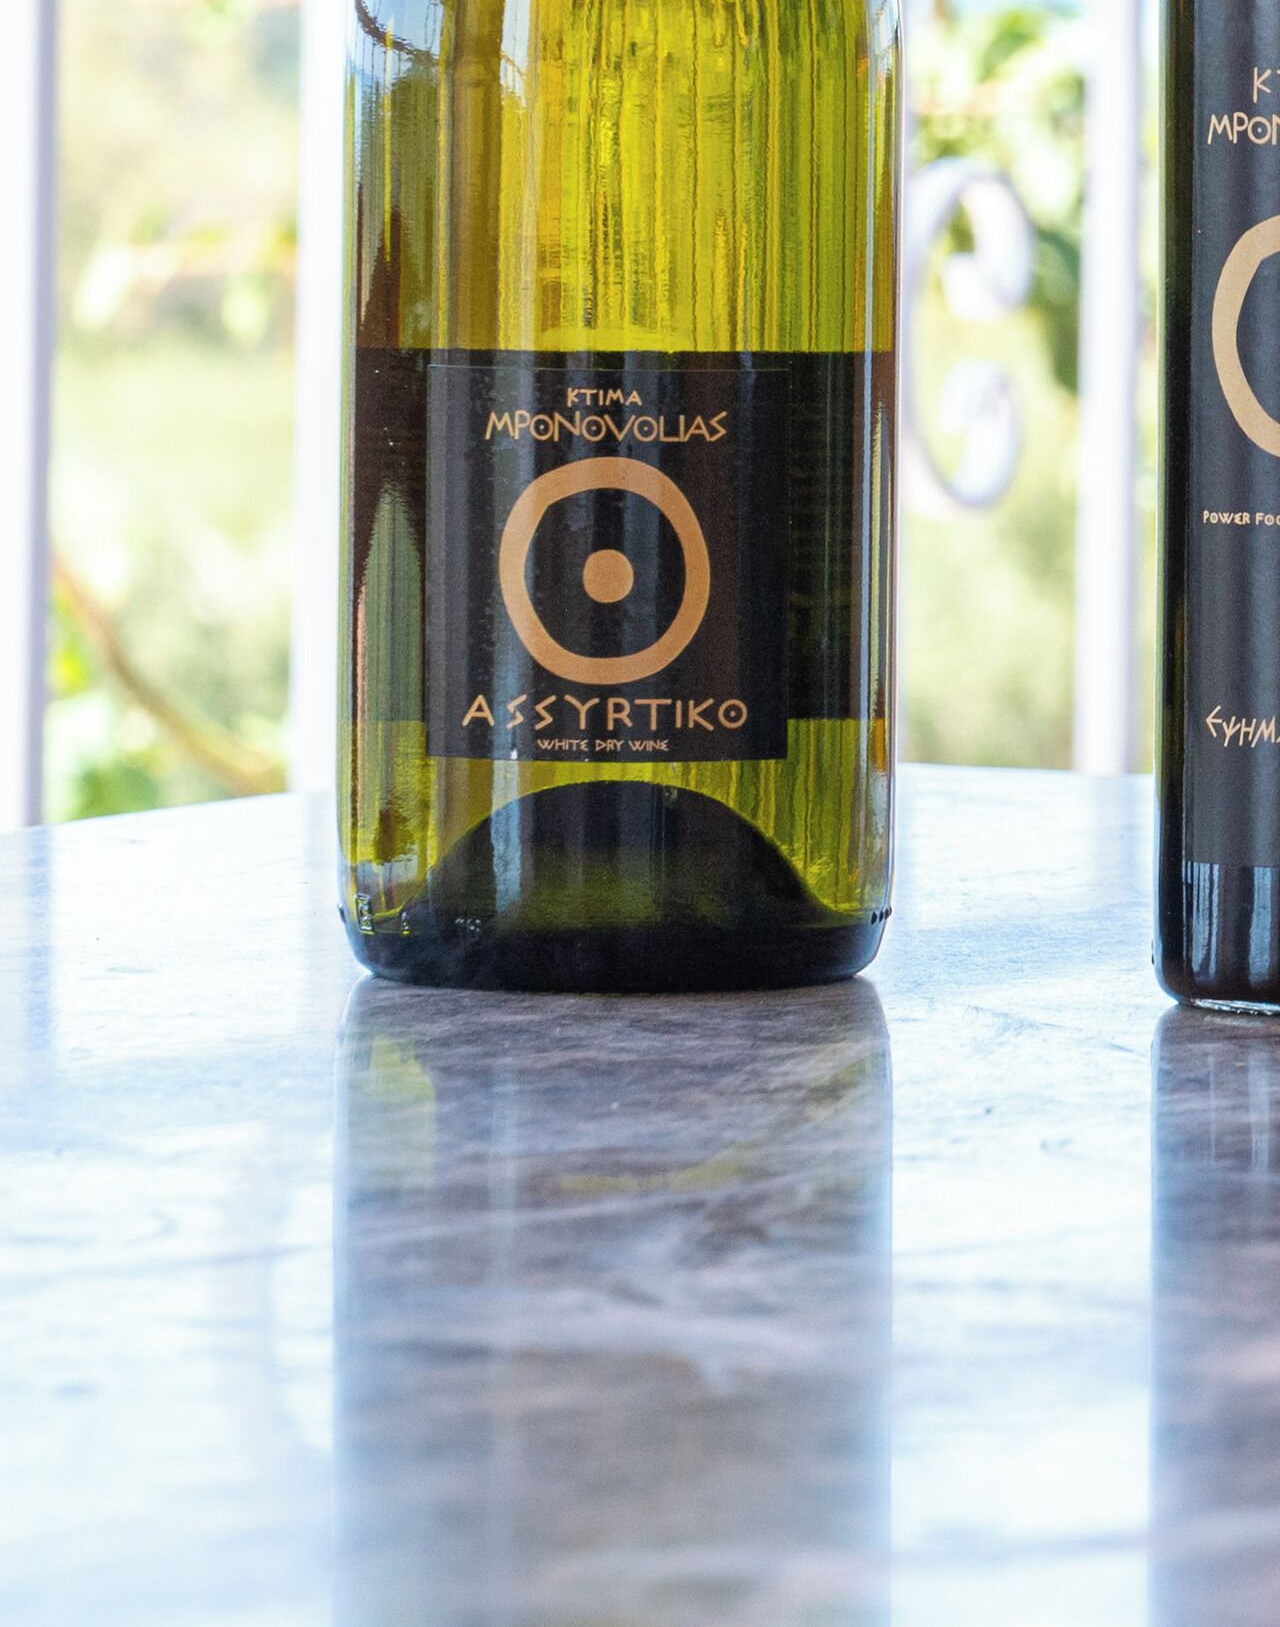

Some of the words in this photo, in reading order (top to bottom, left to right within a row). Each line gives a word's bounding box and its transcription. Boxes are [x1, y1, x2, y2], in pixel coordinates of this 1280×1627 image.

[566, 387, 643, 408] KTIMA
[485, 411, 728, 442] MPONOVOLIAS
[1203, 509, 1250, 525] POWER
[462, 694, 748, 730] ASSYRTIKO
[537, 737, 588, 751] WHITE
[595, 738, 623, 751] DRY
[629, 738, 668, 751] WINE
